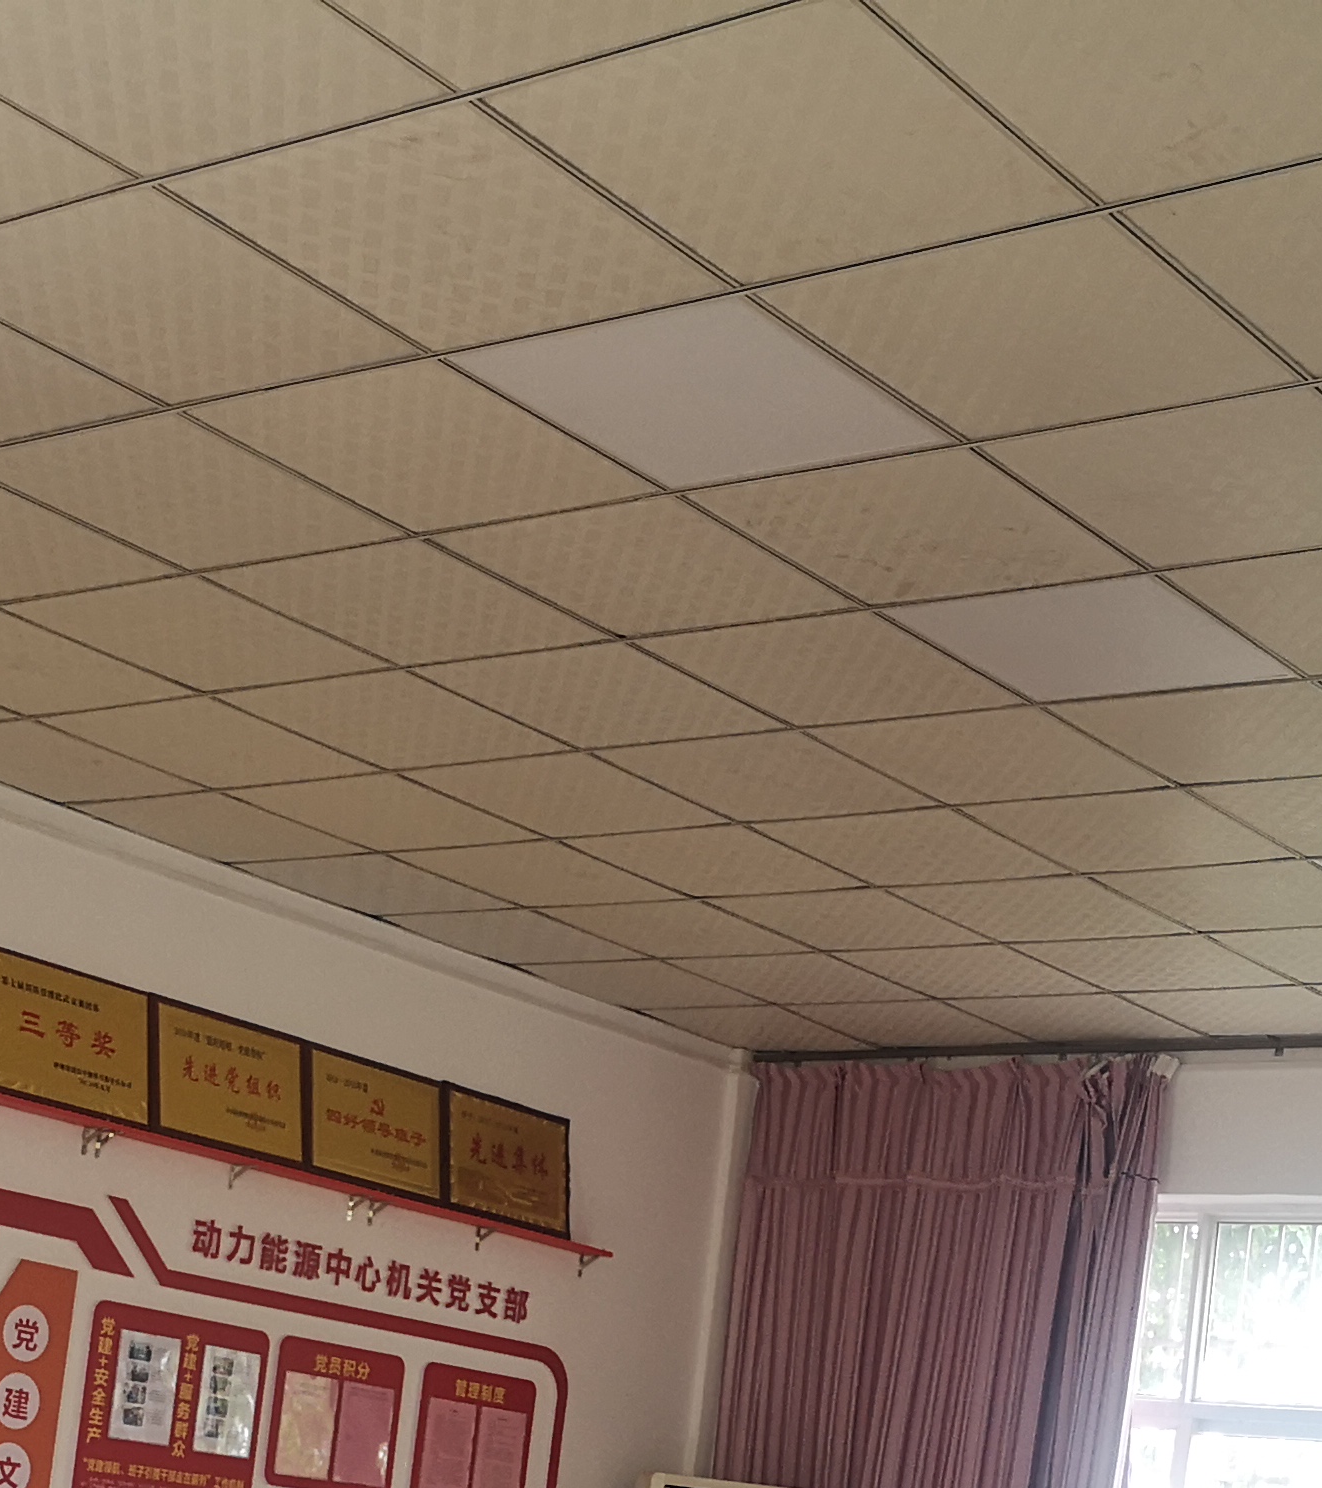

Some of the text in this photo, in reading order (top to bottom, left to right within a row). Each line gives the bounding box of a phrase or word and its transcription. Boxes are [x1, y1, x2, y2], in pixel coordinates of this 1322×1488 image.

[19, 1010, 117, 1059] 三等奖
[191, 1219, 530, 1324] 动力能源中心机关党支部
[86, 1317, 115, 1443] 党建+安全生产
[171, 1333, 199, 1459] 党建+服务群众
[314, 1354, 370, 1380] 党员积分
[455, 1379, 506, 1404] 管理制度
